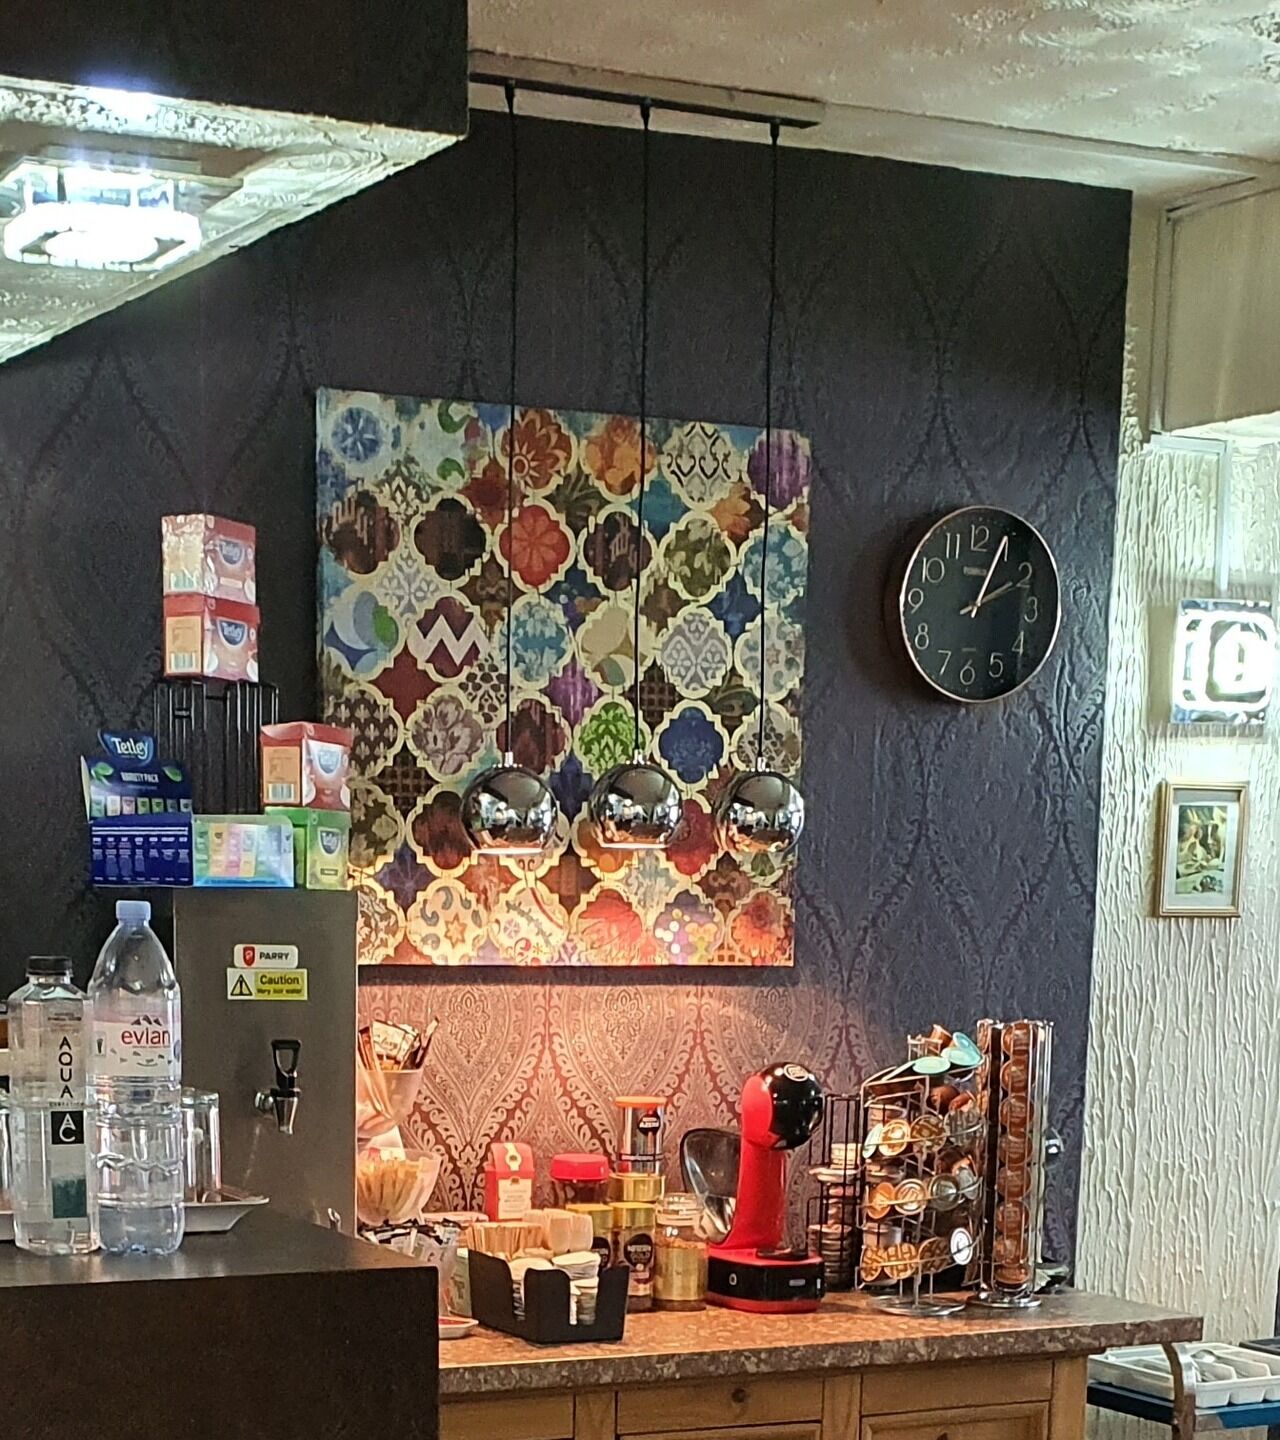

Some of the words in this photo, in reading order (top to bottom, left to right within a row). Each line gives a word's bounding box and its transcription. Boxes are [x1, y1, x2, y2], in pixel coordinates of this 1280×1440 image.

[945, 532, 962, 560] 11
[970, 523, 991, 552] 12
[921, 556, 946, 584] 10
[1015, 561, 1033, 588] 2
[907, 587, 925, 615] 9
[1023, 596, 1039, 623] 3
[914, 622, 930, 650] 8
[1011, 631, 1025, 657] 4
[937, 649, 952, 676] 7
[959, 659, 976, 686] 6
[988, 652, 1004, 678] 5
[111, 737, 148, 760] Tetley
[260, 952, 290, 961] PARRY
[260, 974, 300, 985] Caution
[121, 1027, 171, 1045] evian
[59, 1036, 73, 1098] AQUA
